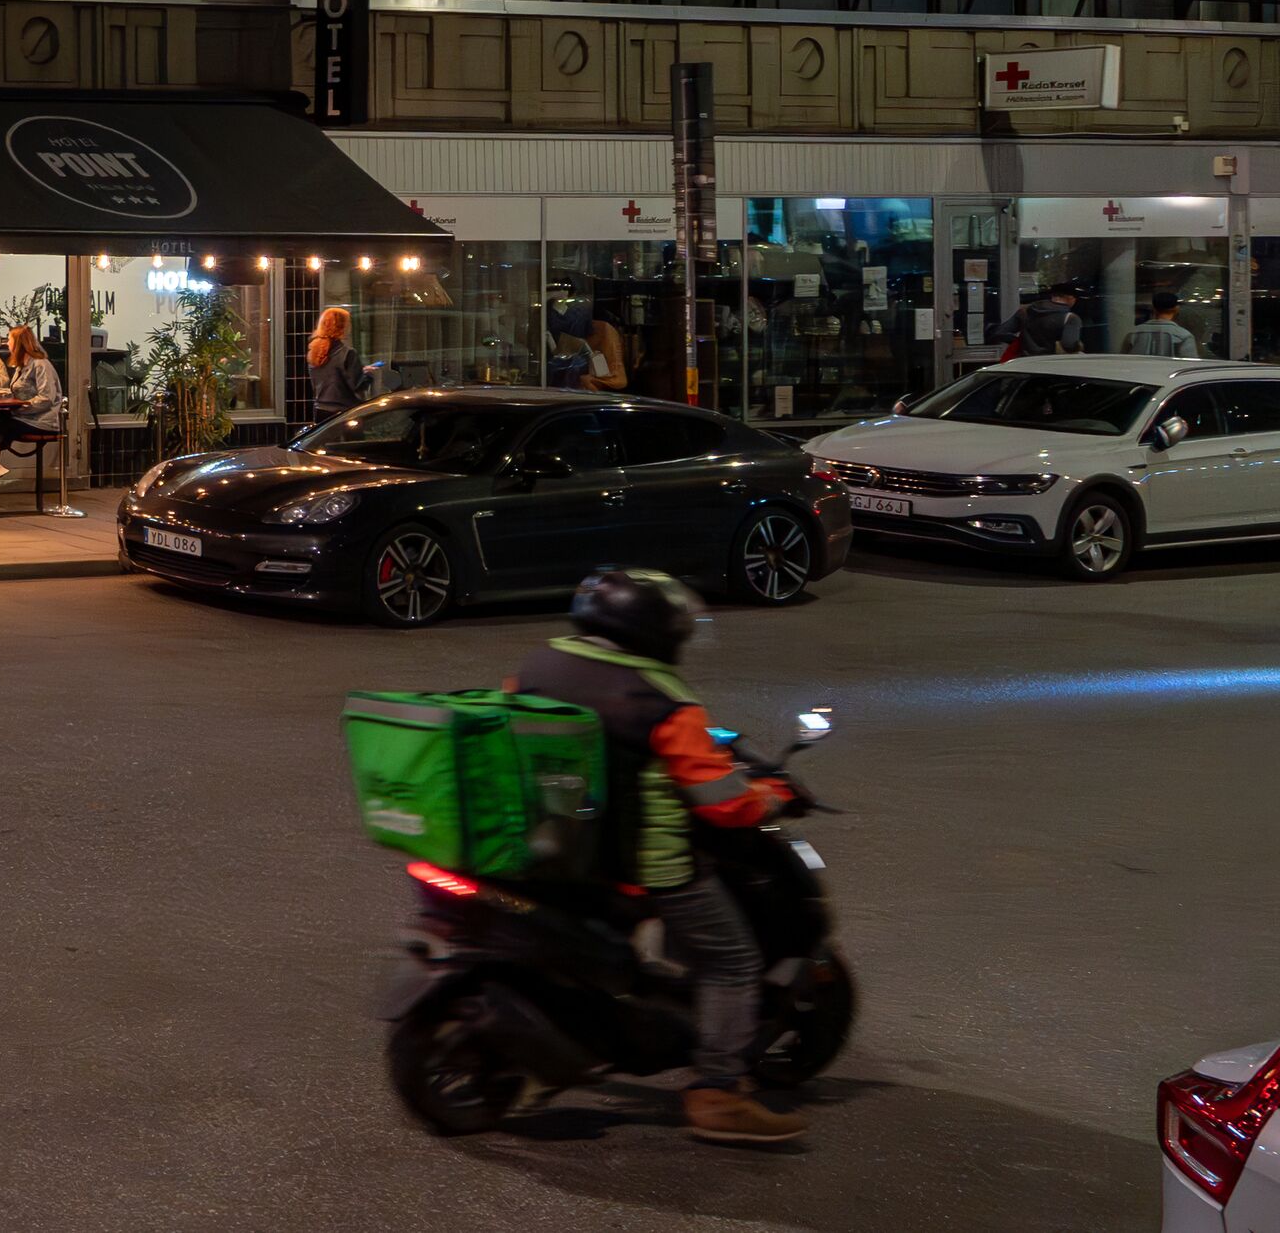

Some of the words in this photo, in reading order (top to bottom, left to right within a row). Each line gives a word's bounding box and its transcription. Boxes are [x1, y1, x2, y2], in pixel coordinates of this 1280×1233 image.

[36, 152, 151, 178] POINT
[151, 240, 195, 254] HOTEL
[148, 271, 213, 292] HOT
[850, 496, 871, 509] GJ
[876, 500, 903, 514] 66J
[151, 531, 170, 548] YDL
[173, 536, 197, 554] 086
